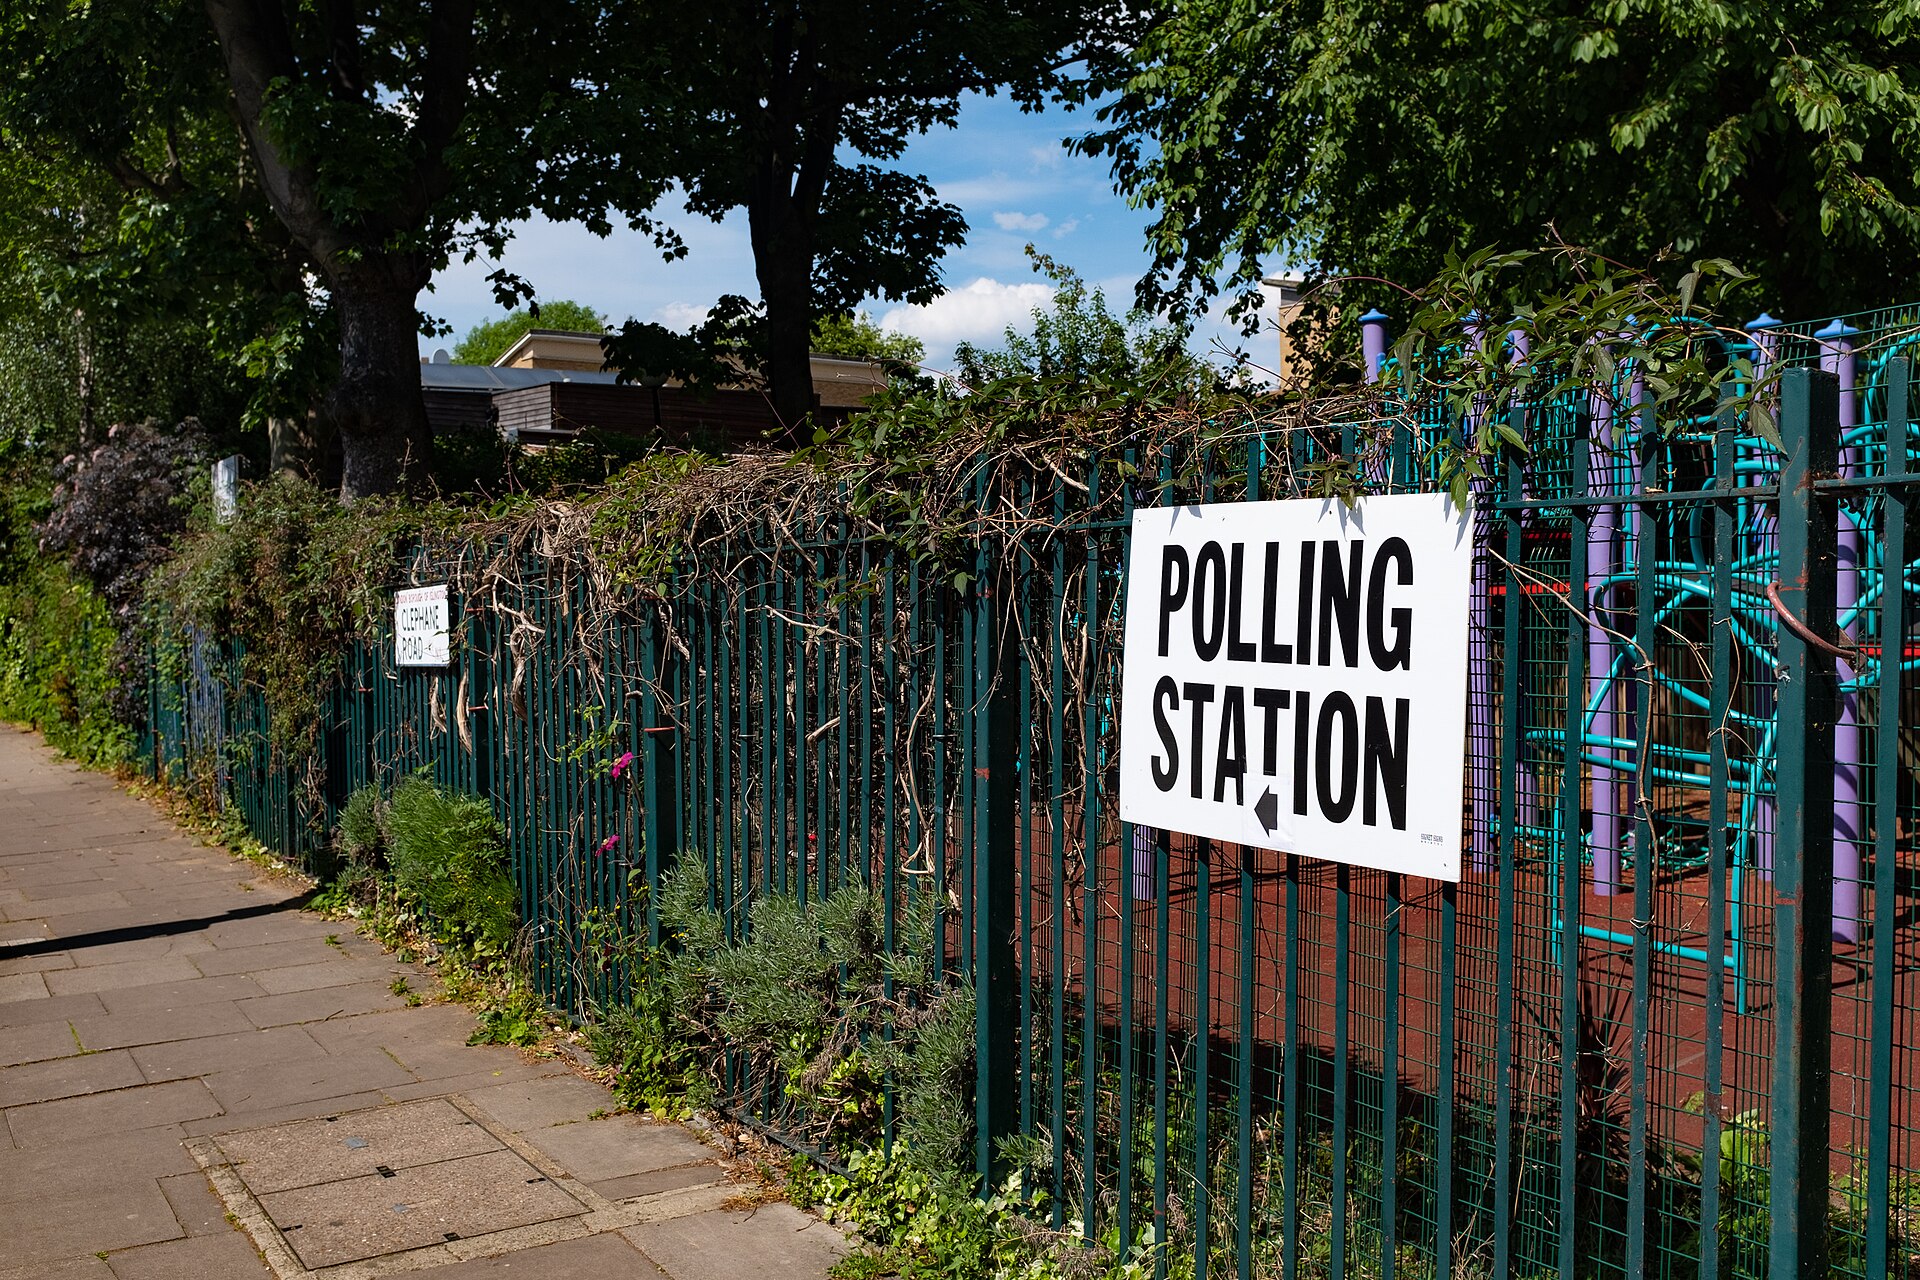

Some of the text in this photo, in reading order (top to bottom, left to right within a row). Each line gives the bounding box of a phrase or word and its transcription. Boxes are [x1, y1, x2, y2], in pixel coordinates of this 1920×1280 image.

[424, 591, 429, 602] OF
[1157, 536, 1414, 671] POLLING
[401, 605, 440, 631] CLEPHANE
[402, 636, 423, 660] ROAD
[1150, 675, 1410, 831] STATION
